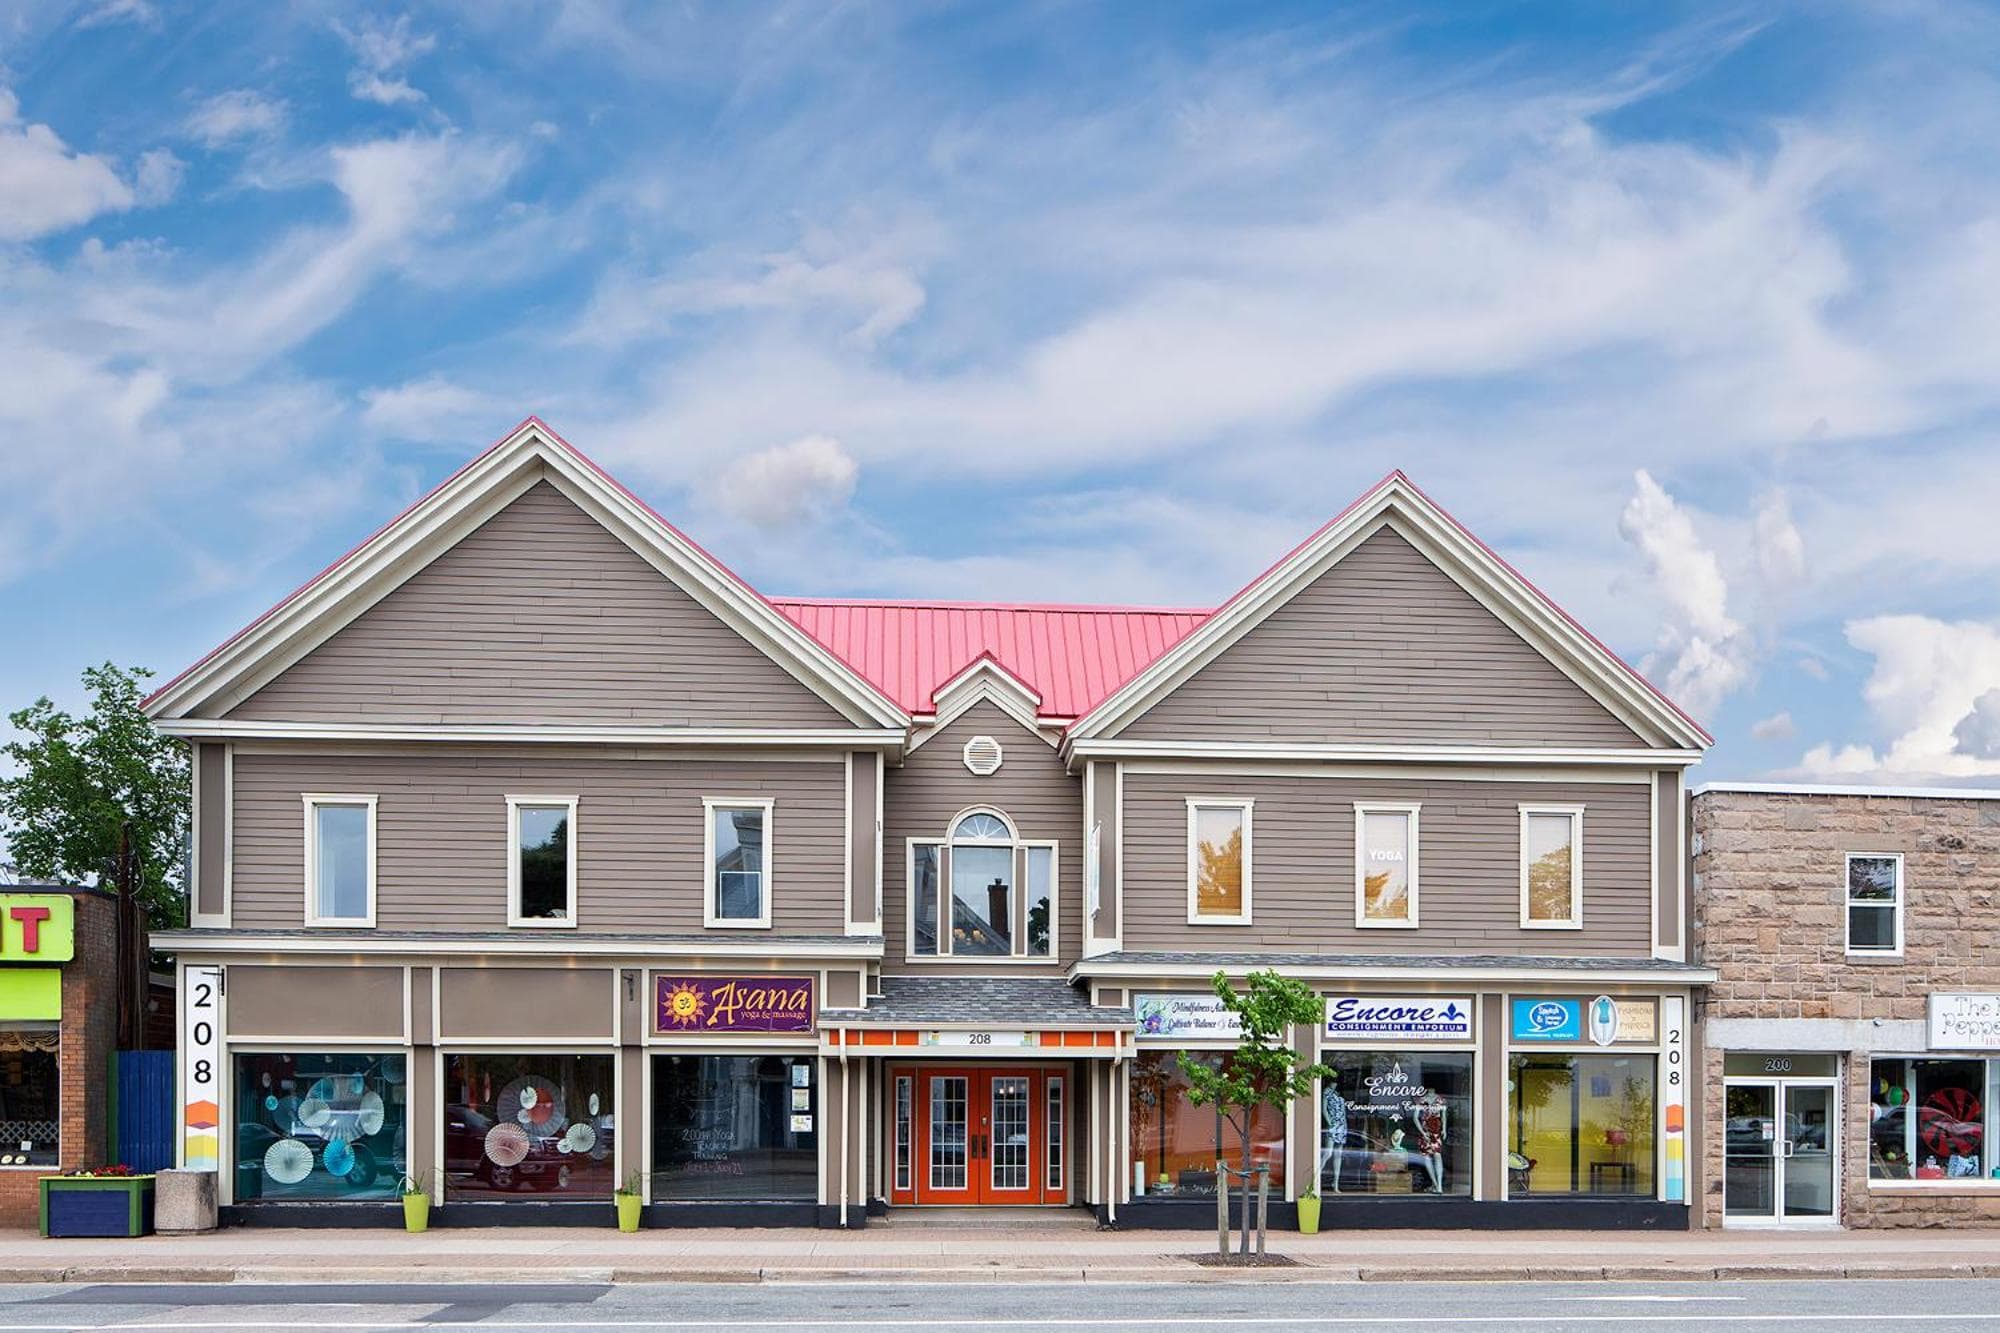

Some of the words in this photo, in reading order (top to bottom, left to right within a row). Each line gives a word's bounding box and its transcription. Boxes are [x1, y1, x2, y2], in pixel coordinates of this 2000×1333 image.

[1369, 849, 1403, 861] YOGA
[0, 907, 50, 953] T
[706, 981, 808, 1026] Asana
[1172, 1002, 1210, 1015] Mindfulness
[1332, 999, 1434, 1021] Encore
[1954, 996, 1991, 1017] The
[740, 1011, 760, 1019] yoga
[1168, 1018, 1192, 1031] Cultivate
[1193, 1018, 1217, 1028] Balance
[194, 983, 212, 1084] 208
[969, 1033, 992, 1045] 208
[1669, 1029, 1680, 1085] 208
[1765, 1058, 1792, 1071] 200
[1364, 1077, 1427, 1097] Encore
[1345, 1100, 1399, 1113] Consignment
